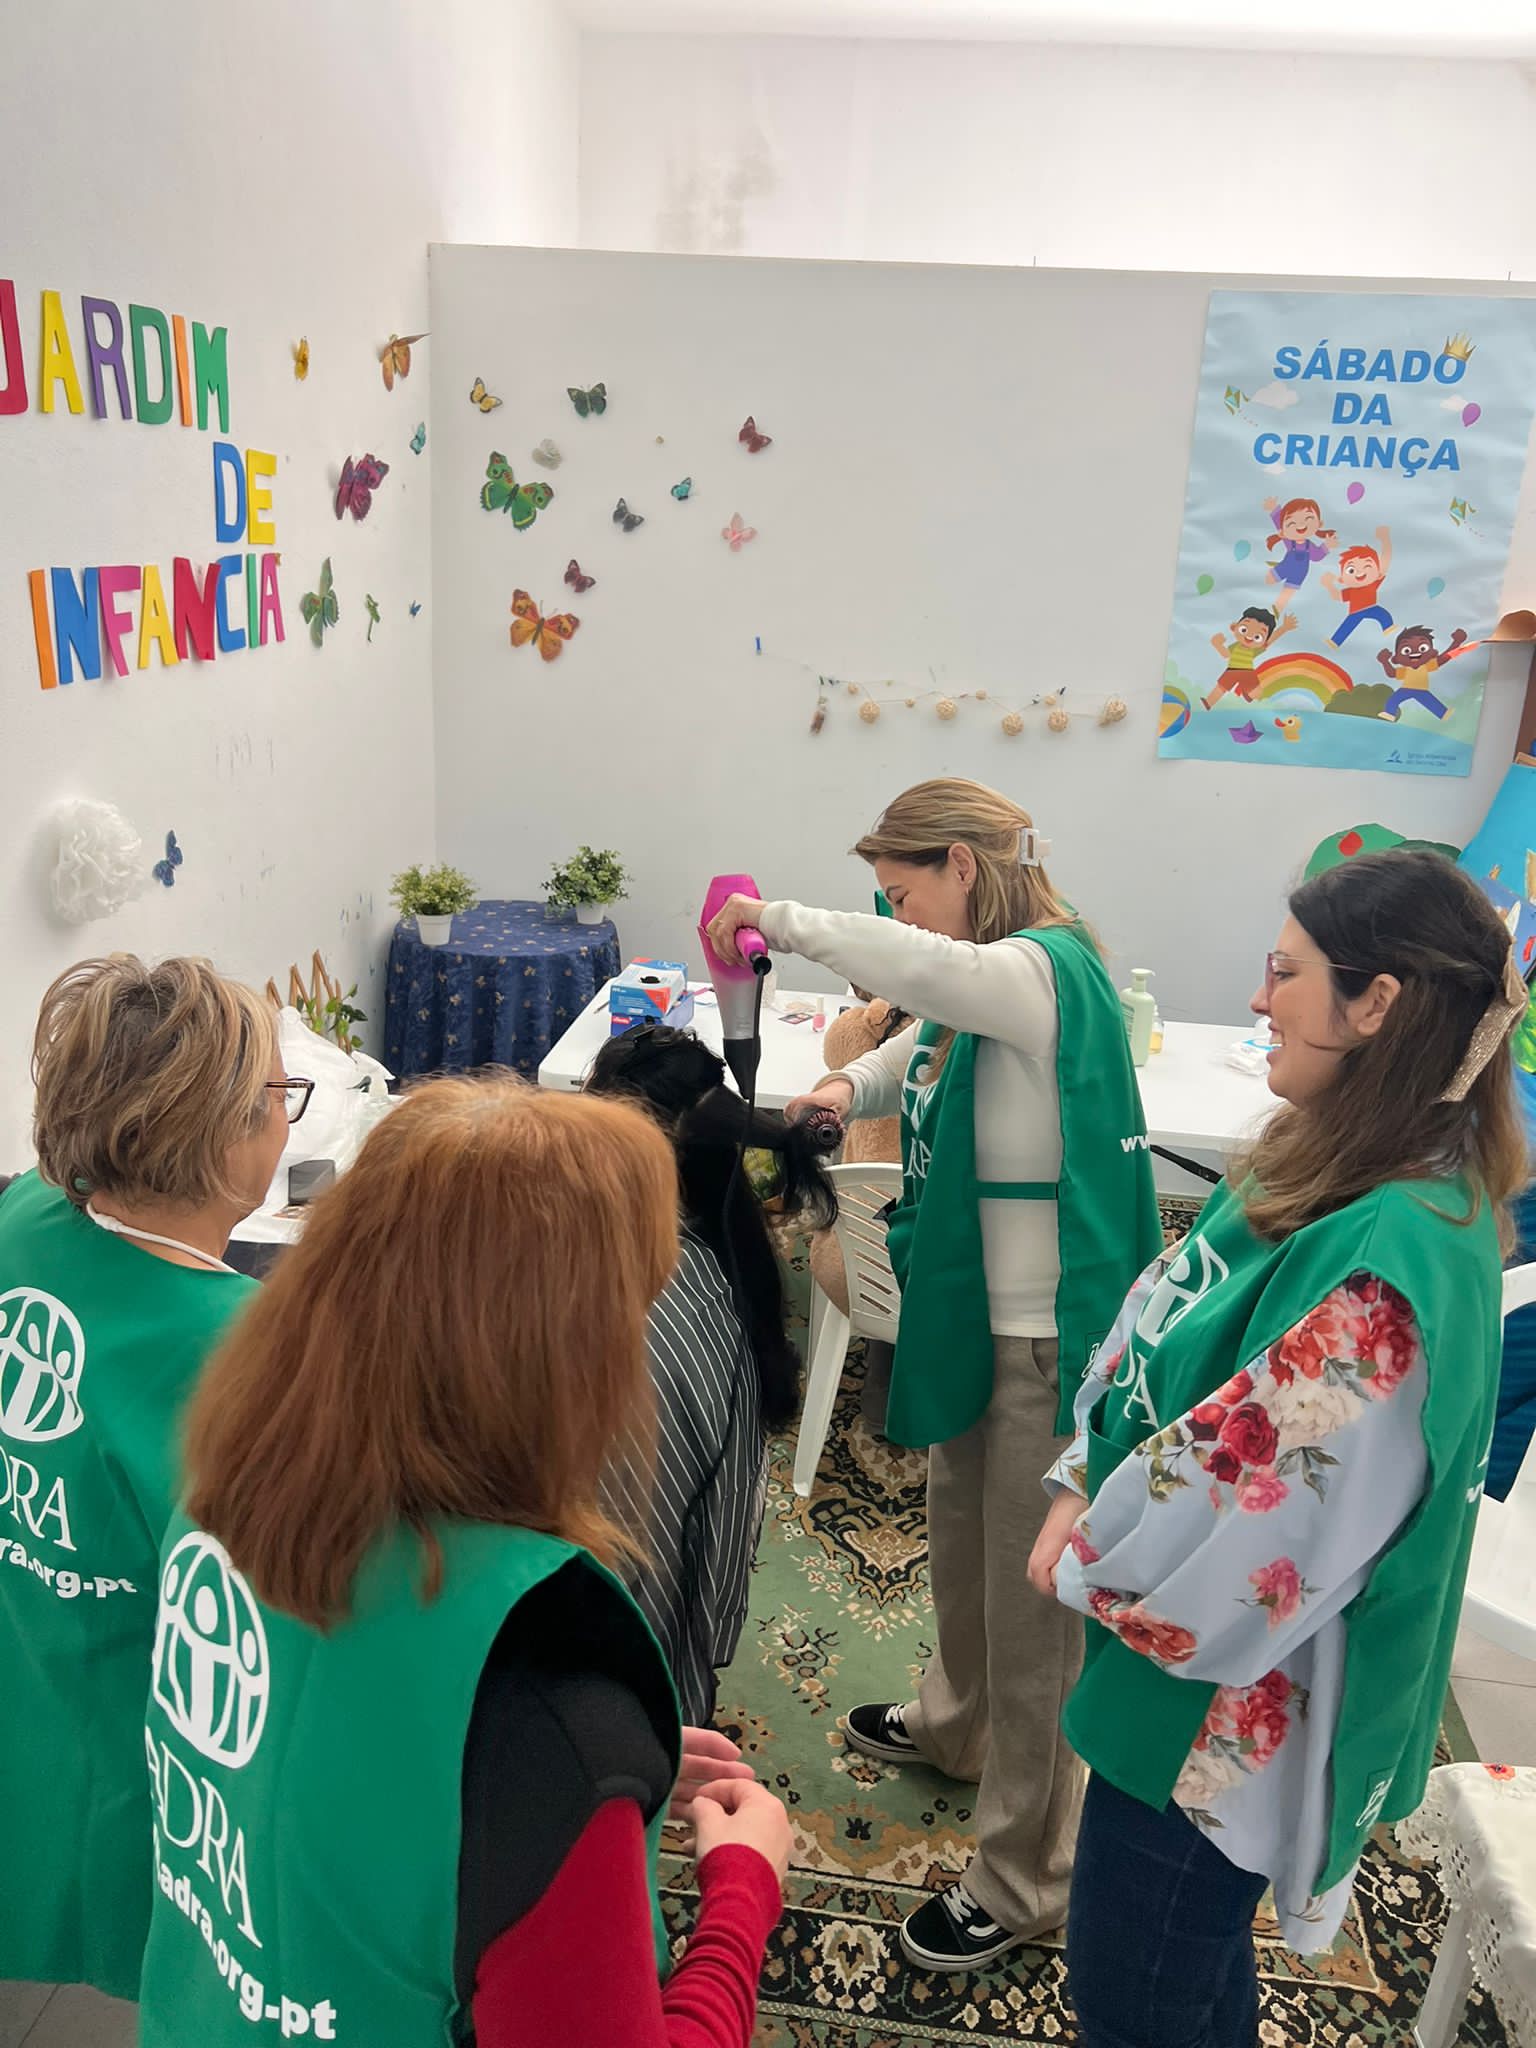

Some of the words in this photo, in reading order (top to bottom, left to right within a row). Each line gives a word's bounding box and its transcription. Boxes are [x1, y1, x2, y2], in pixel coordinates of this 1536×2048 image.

[0, 279, 229, 433] JARDIM
[1273, 339, 1466, 385] SÁBADO
[1332, 392, 1392, 426] DA
[1253, 432, 1460, 478] CRIANÇA
[213, 441, 277, 545] DE
